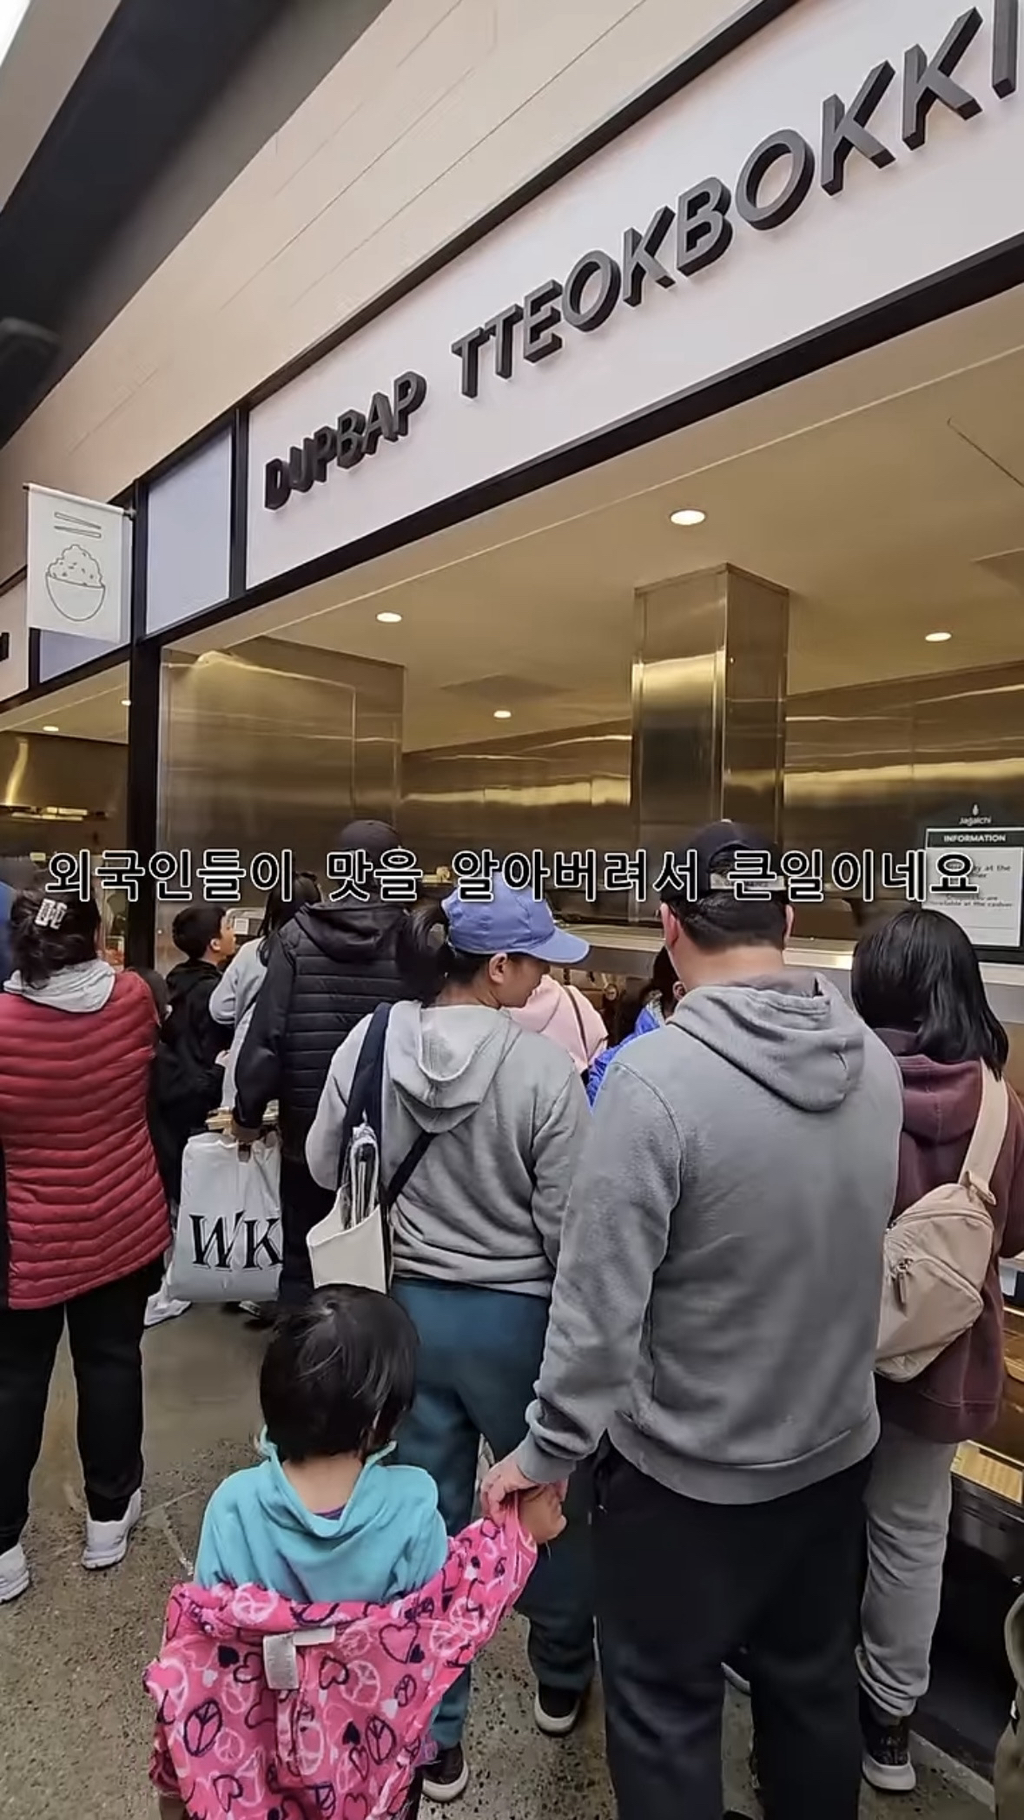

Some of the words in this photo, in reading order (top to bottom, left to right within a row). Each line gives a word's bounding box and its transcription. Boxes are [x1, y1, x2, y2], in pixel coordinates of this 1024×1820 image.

[264, 370, 428, 511] DUPBAP
[450, 0, 1019, 399] TTEOKBOKKI
[943, 834, 1006, 843] INFORMATION
